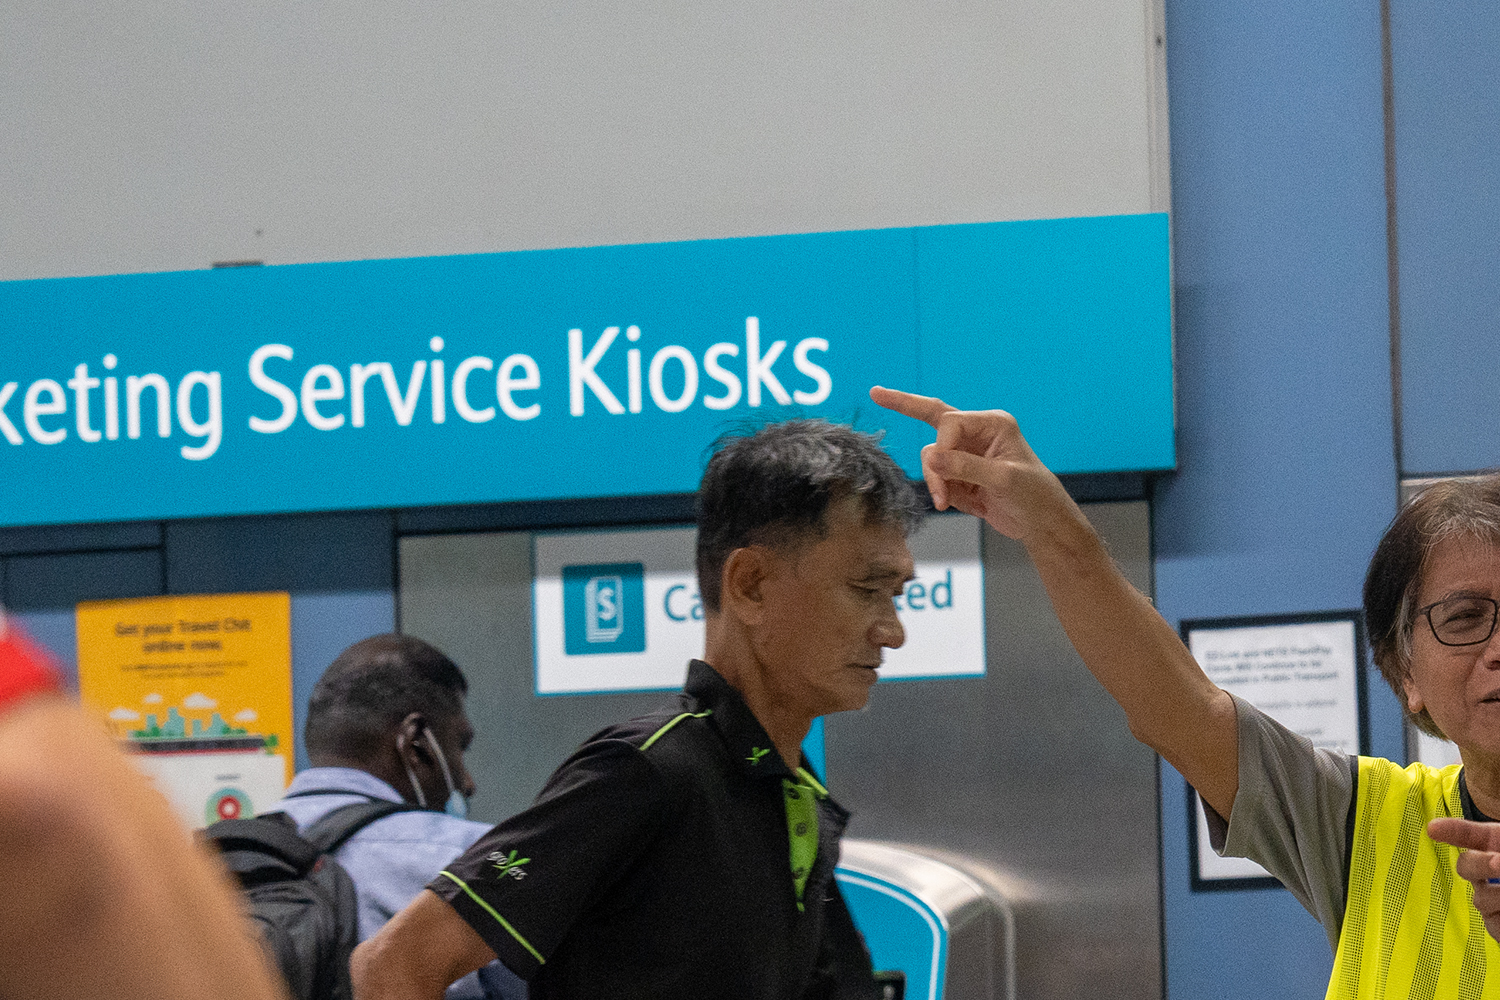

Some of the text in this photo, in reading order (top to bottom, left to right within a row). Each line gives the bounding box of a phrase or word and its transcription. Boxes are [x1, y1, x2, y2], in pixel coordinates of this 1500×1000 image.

[0, 316, 832, 461] keting Service Kiosks
[893, 568, 953, 612] ed
